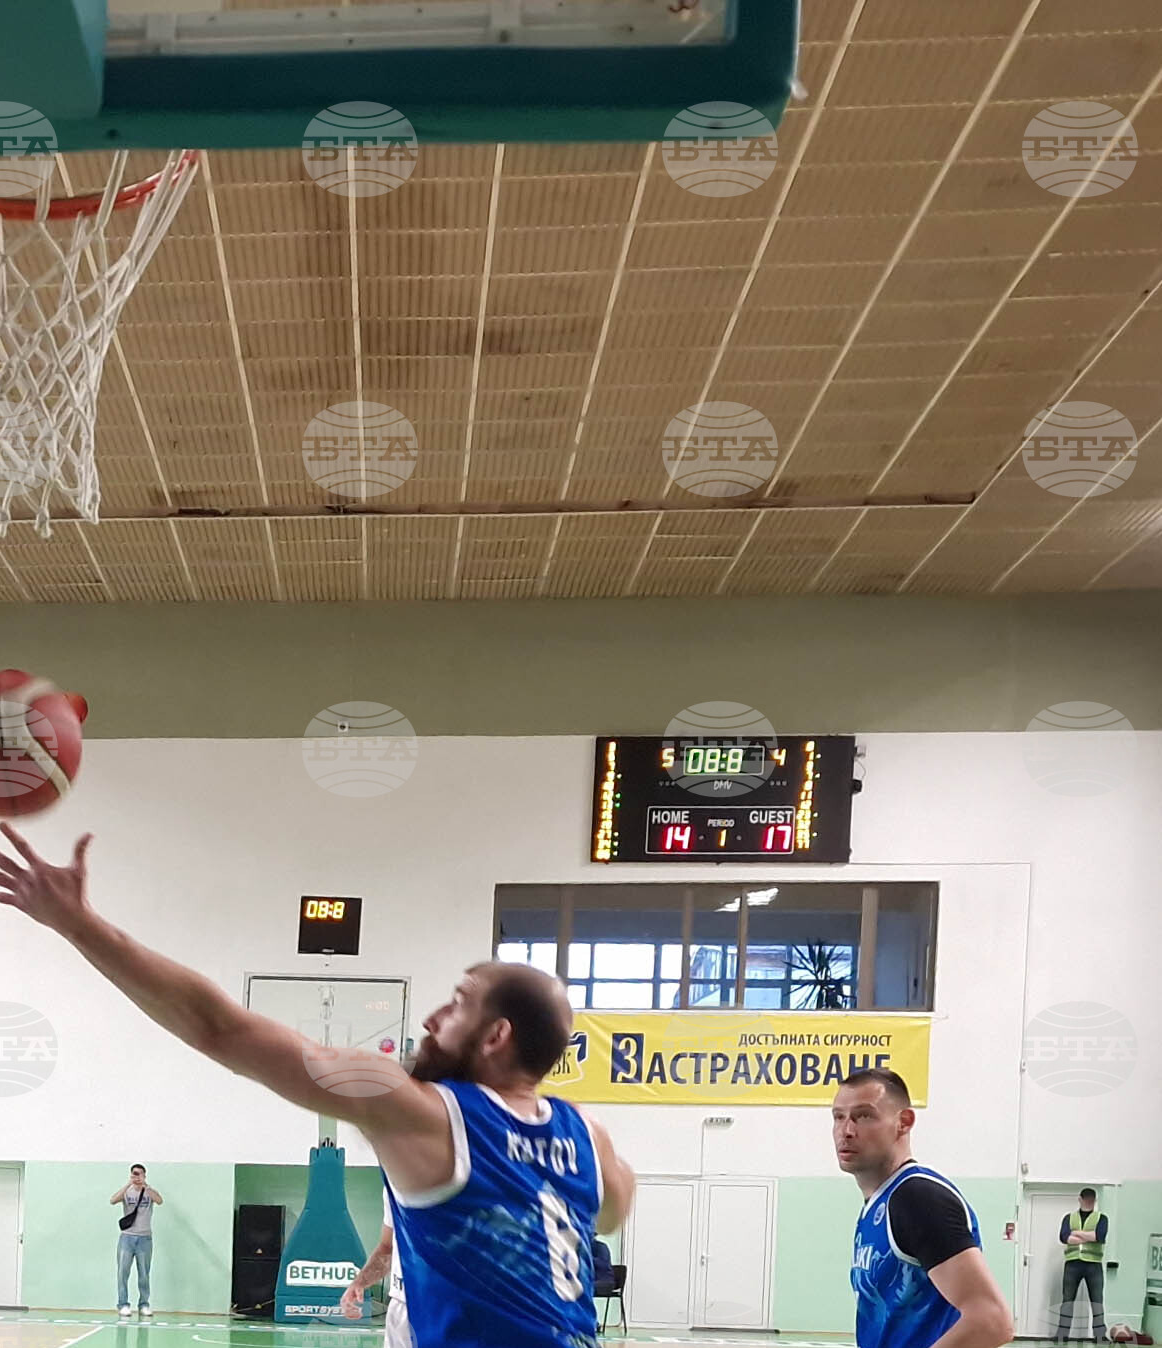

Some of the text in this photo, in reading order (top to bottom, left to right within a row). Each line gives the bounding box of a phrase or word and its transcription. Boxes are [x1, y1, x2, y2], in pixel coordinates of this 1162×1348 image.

[661, 748, 676, 768] 5
[687, 748, 743, 774] 08:8
[772, 748, 786, 766] 4
[651, 810, 793, 828] HOME PERIOD GUEST
[665, 826, 691, 850] 14
[718, 829, 727, 847] 1
[764, 825, 791, 850] 17
[305, 900, 345, 919] 08:8
[738, 1033, 892, 1048] ДОСТЪПНАТА СИГУРНОСТ
[289, 1265, 358, 1282] BETHUB
